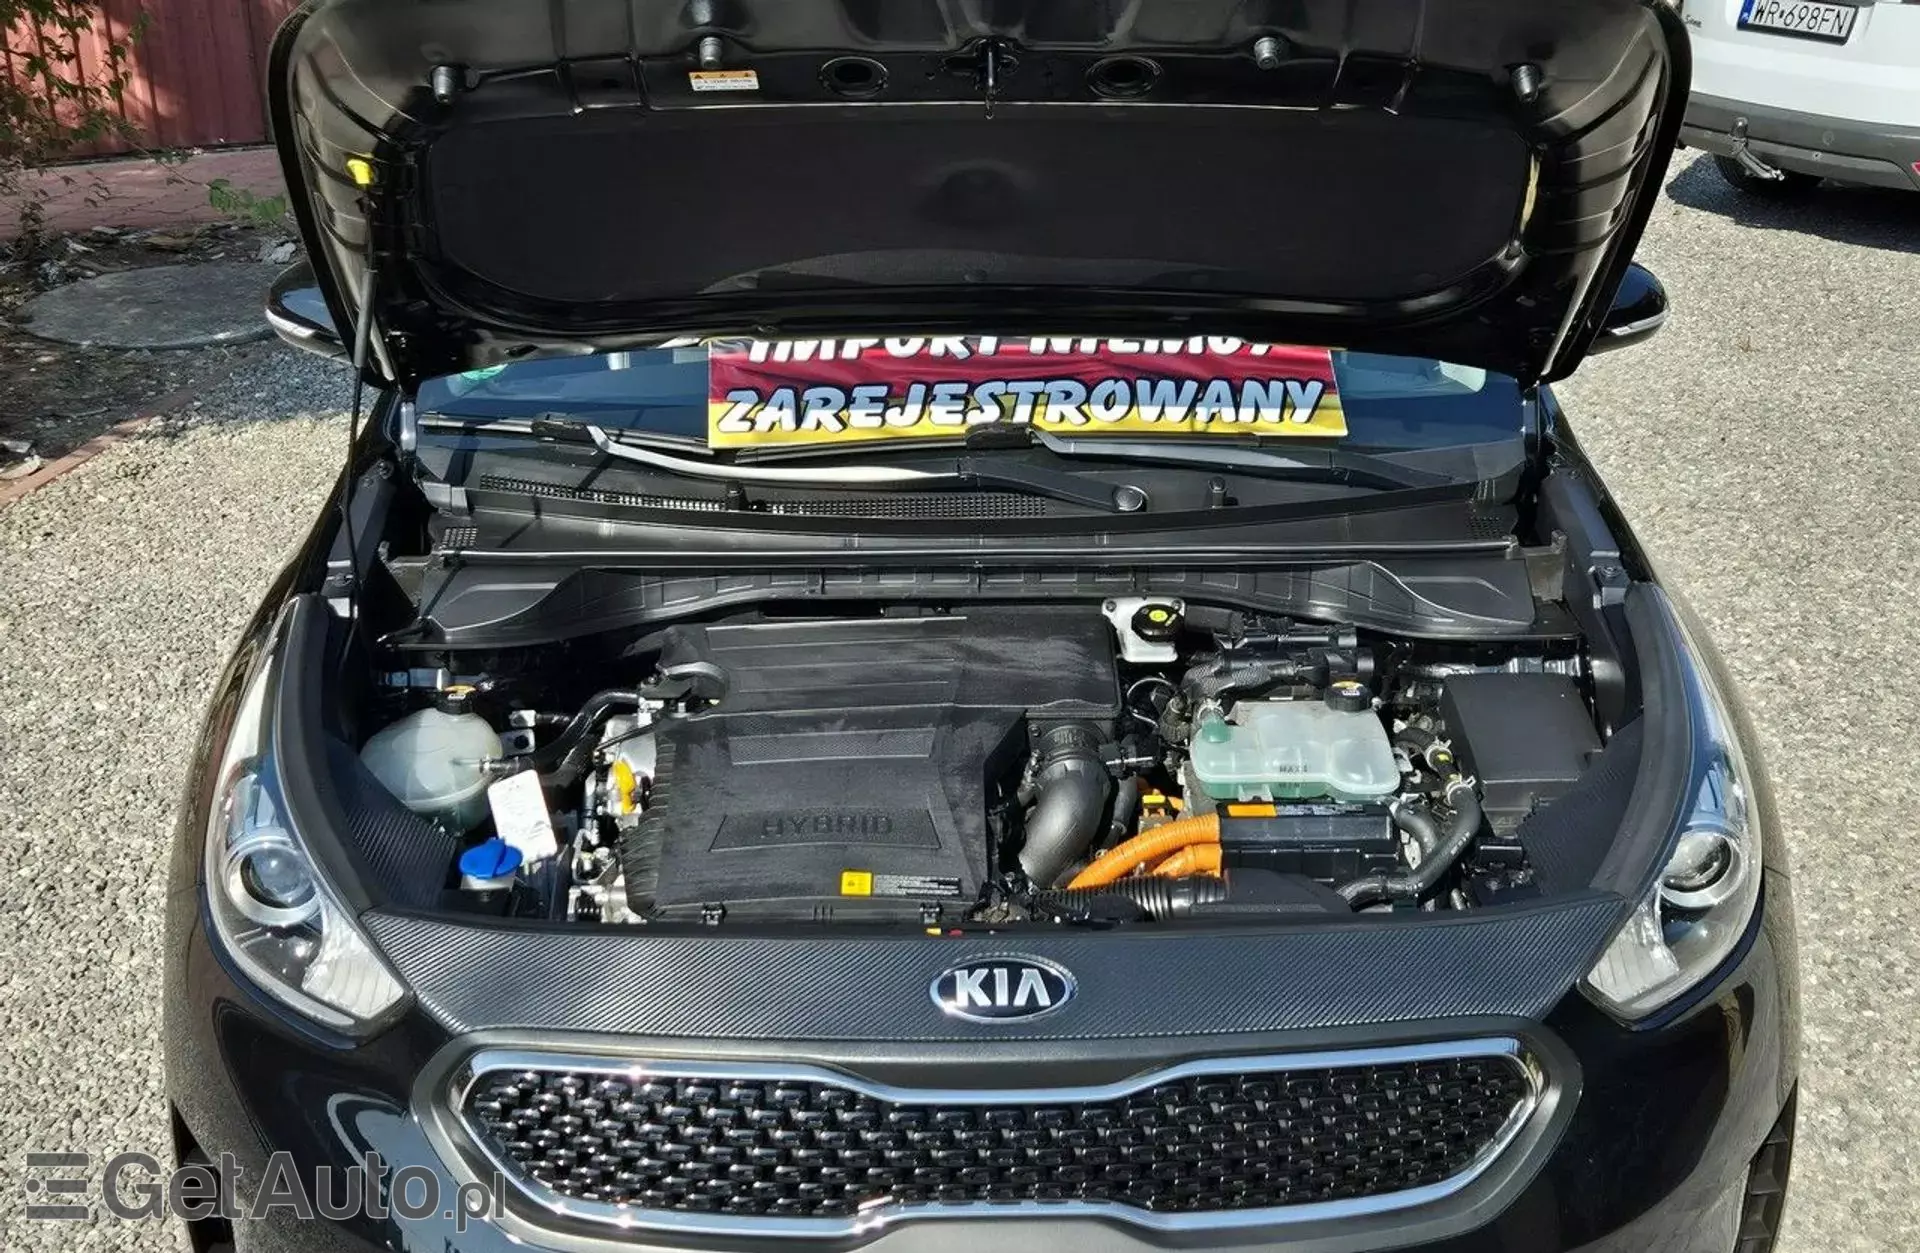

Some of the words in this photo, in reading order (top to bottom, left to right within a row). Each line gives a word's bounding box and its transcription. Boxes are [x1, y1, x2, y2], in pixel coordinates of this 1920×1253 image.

[717, 379, 1323, 432] ZAREJESTROWANY
[762, 814, 893, 838] HYBRID
[953, 967, 1052, 1007] KIA
